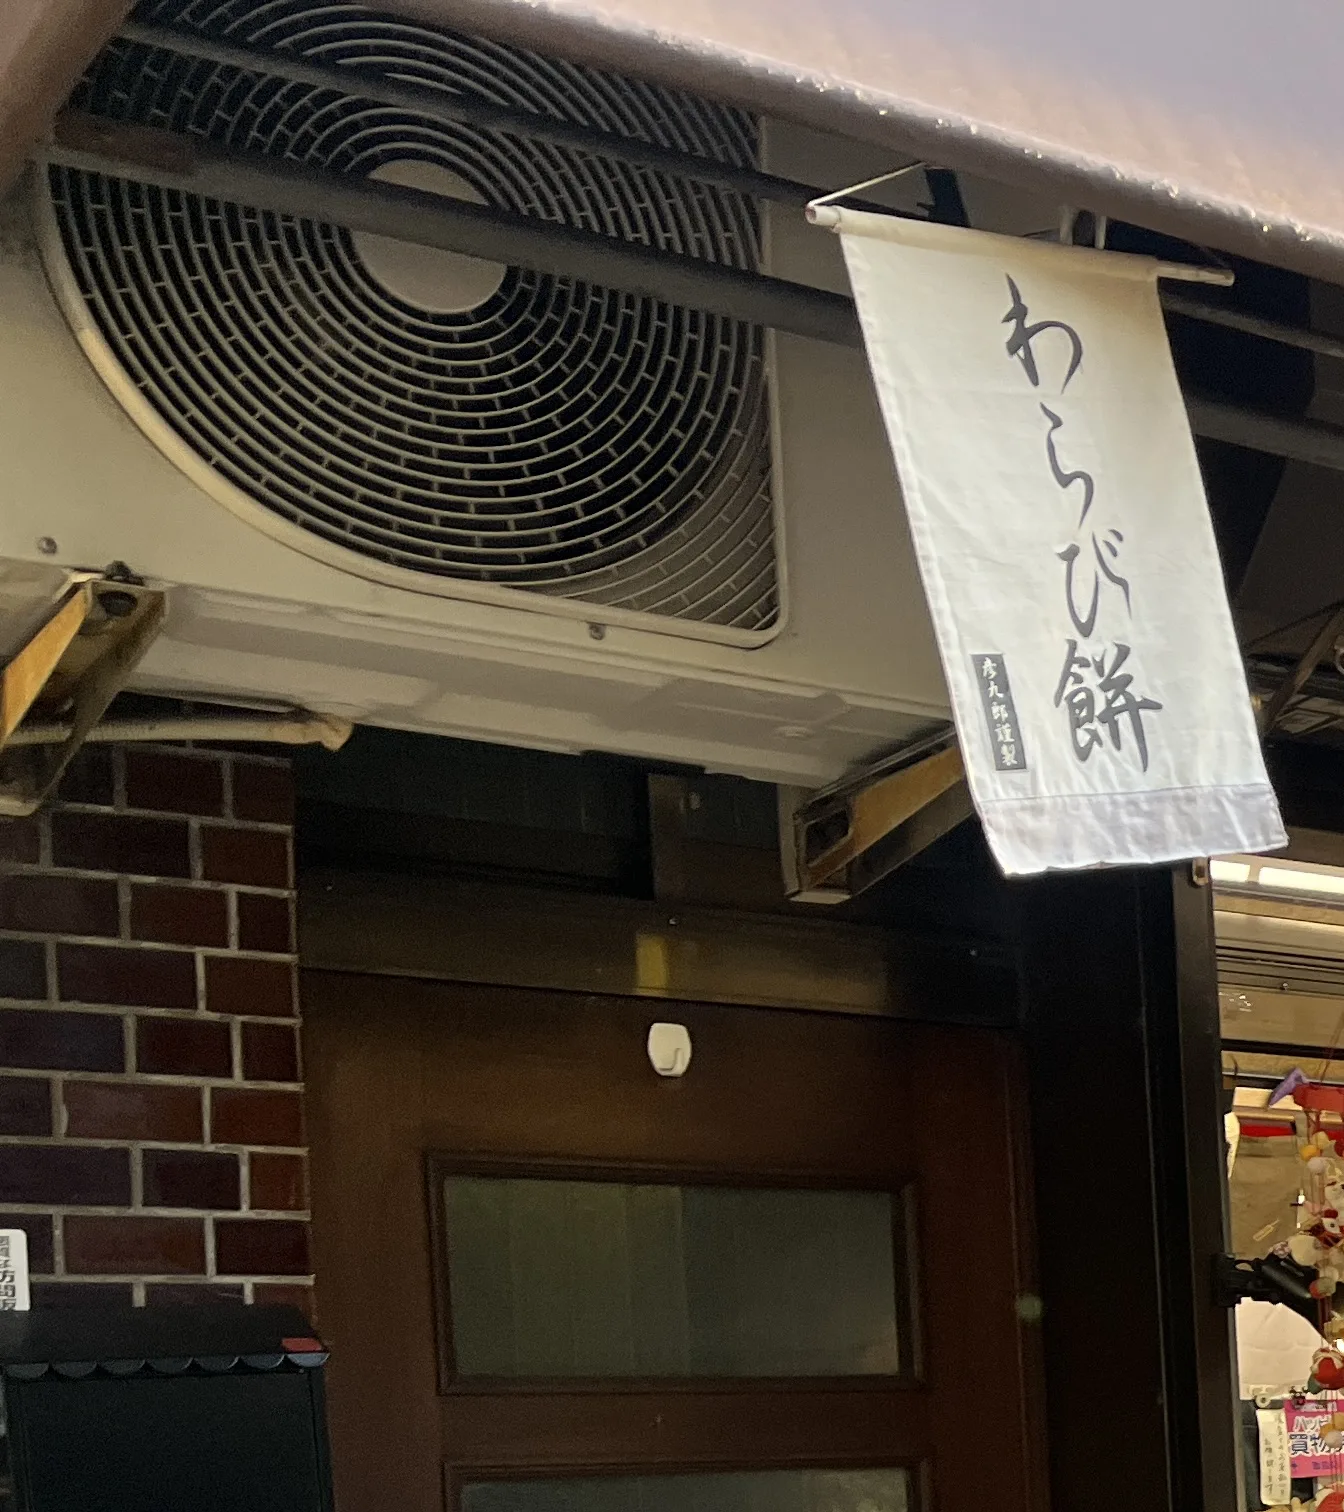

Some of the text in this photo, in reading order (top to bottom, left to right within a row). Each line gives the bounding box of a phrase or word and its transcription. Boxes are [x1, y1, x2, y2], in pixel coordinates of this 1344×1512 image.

[1001, 273, 1164, 771] わらび餅
[982, 657, 1018, 766] 彦九郎謹製
